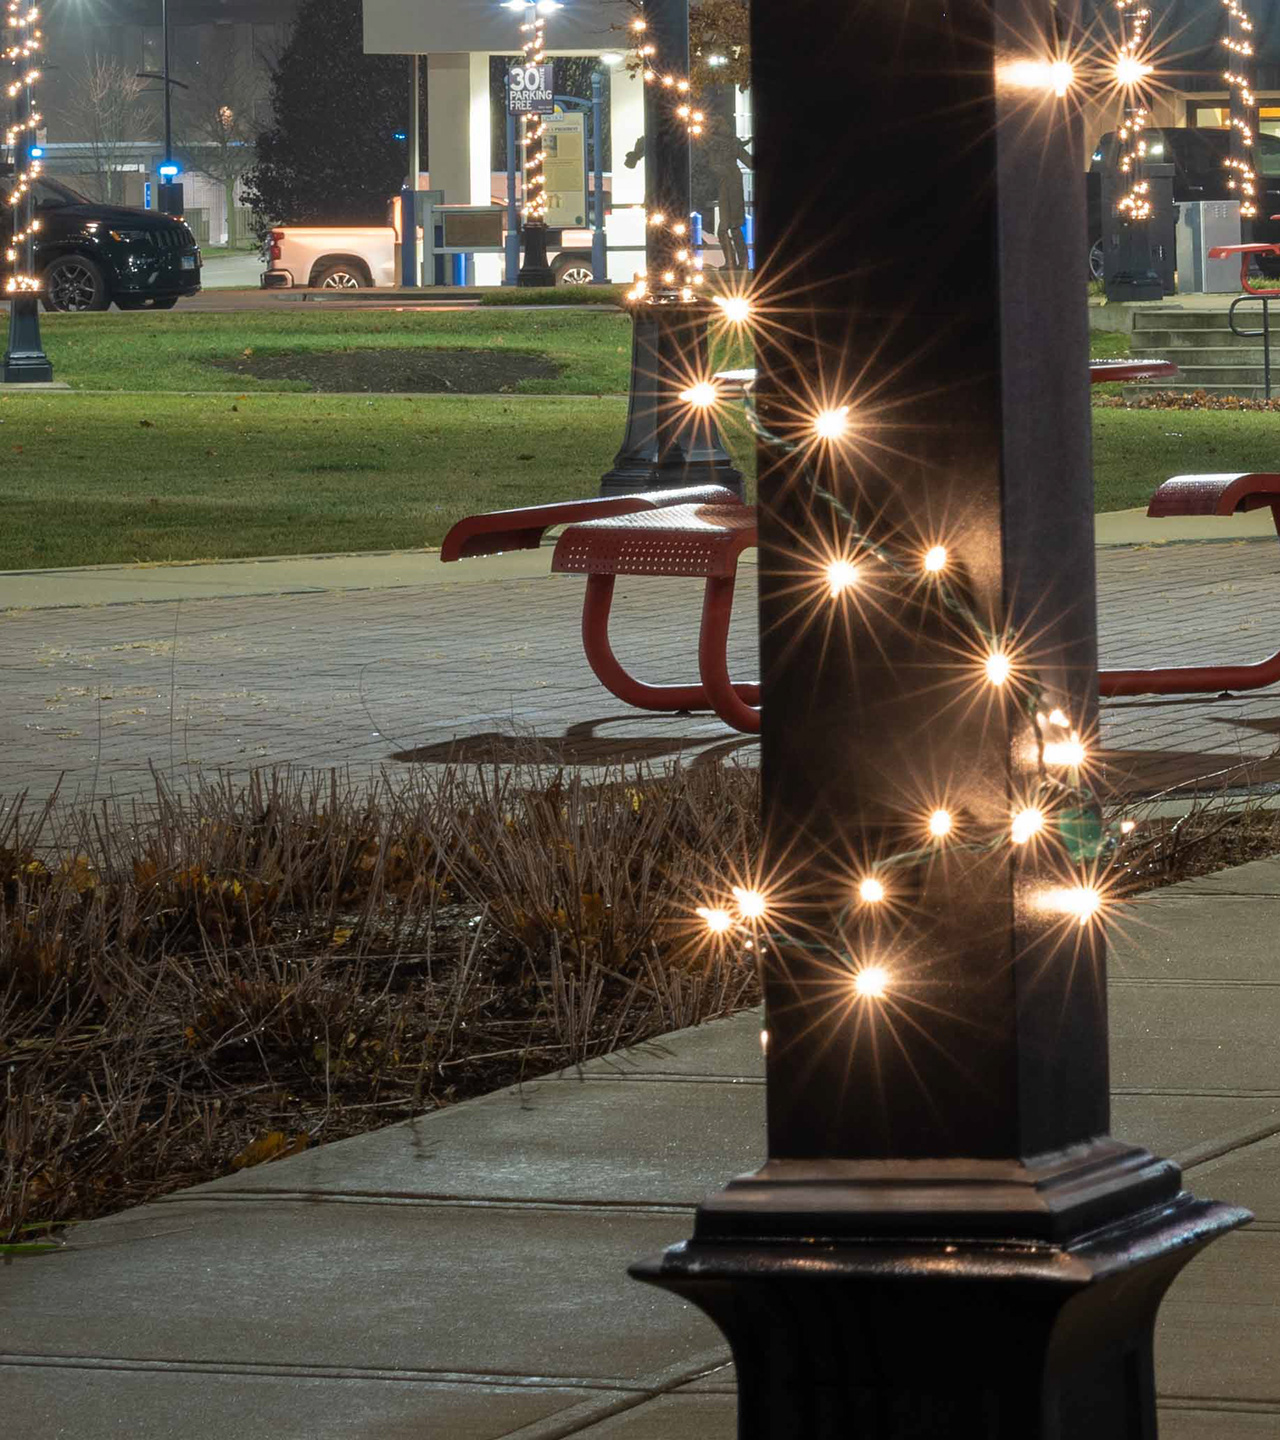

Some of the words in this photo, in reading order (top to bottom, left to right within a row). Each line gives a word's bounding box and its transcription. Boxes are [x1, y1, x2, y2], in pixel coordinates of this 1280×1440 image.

[510, 67, 540, 91] 30
[510, 90, 552, 100] PARKING
[510, 100, 532, 110] FREE
